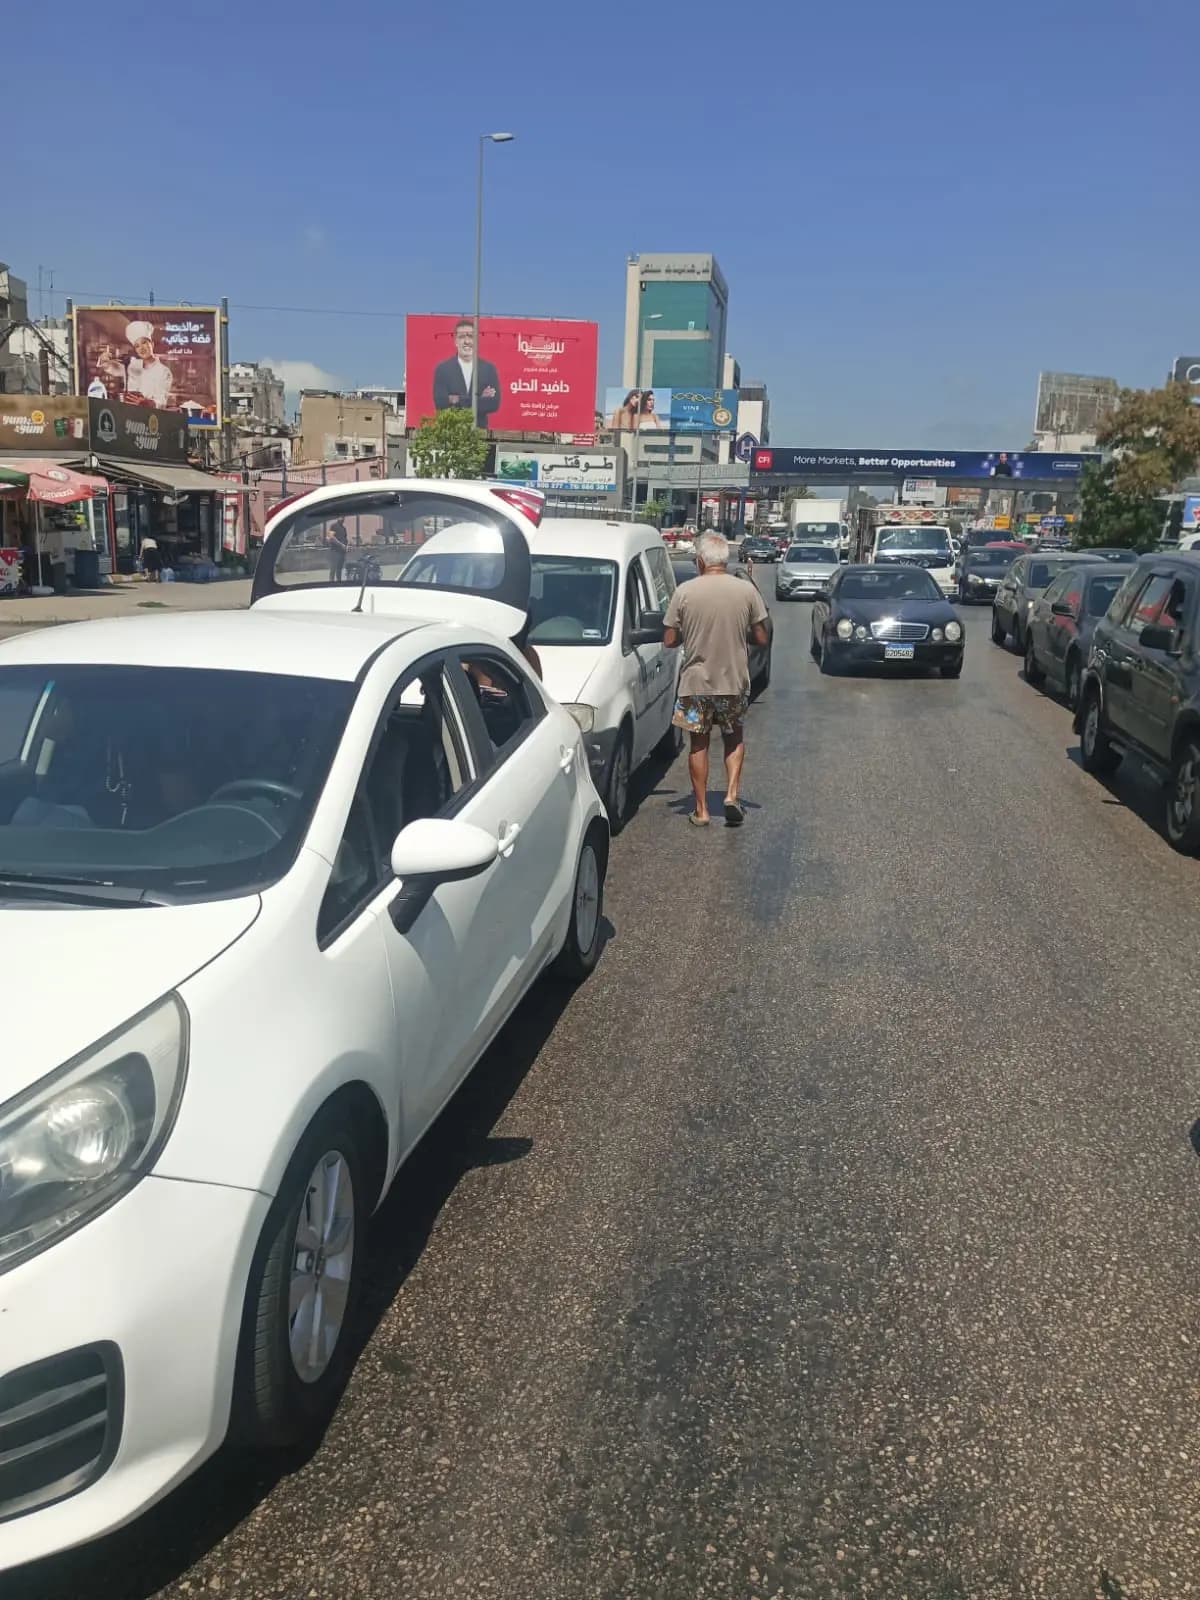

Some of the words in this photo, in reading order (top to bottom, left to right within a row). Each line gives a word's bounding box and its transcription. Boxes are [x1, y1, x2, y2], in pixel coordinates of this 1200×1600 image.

[510, 378, 538, 394] الحلو
[541, 380, 570, 395] دافيد
[793, 455, 816, 465] More
[818, 456, 857, 467] Markets,
[858, 457, 888, 466] Better
[891, 457, 956, 468] Opportunities
